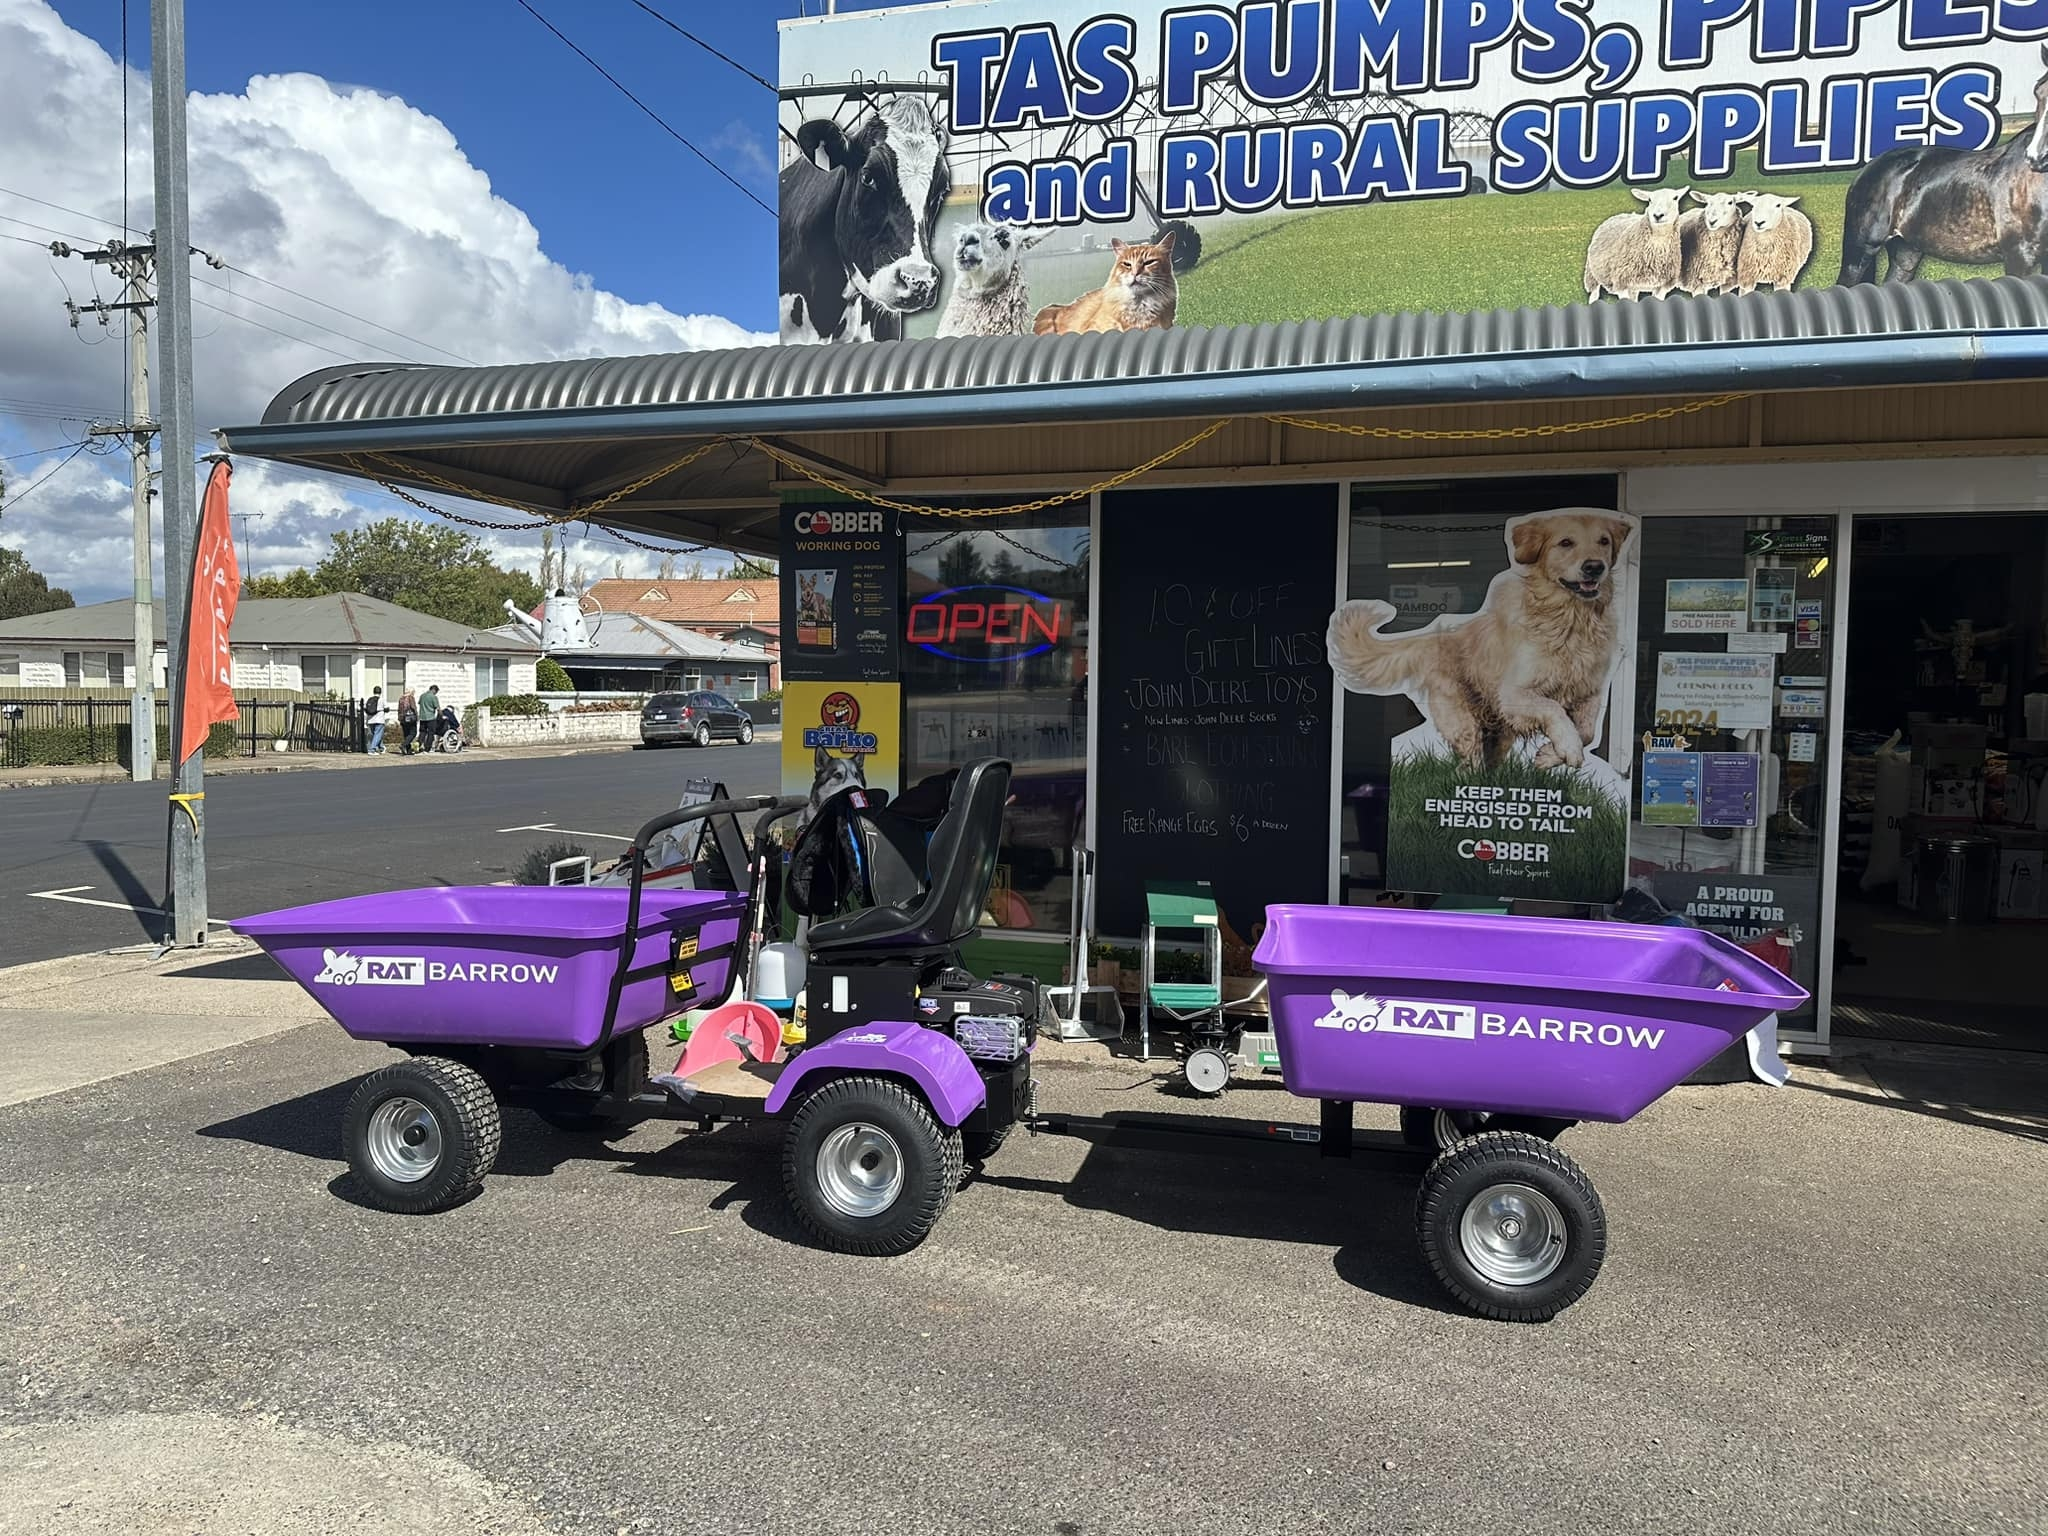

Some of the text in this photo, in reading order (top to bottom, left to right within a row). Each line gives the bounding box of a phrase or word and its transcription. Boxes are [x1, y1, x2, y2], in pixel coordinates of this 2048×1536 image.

[933, 18, 1136, 133] TAS
[1162, 0, 1640, 110] PUMPS,
[984, 64, 2000, 224] and RURAL SUPPLIES
[794, 511, 883, 534] COBBER
[796, 541, 880, 551] WORKING DOG
[1230, 583, 1295, 619] OFF
[907, 603, 1061, 644] OPEN
[1671, 619, 1737, 629] SOLD HERE
[1184, 624, 1322, 675] GIFT LINES
[1129, 672, 1317, 710] JOHN DEERE TOYS
[1249, 711, 1277, 723] SOCKS
[1655, 709, 1718, 735] 2024
[804, 729, 877, 748] Barko
[967, 729, 987, 737] 224
[1651, 737, 1676, 748] RAW
[1455, 785, 1562, 802] KEEP THEM
[1425, 799, 1592, 819] ENERGISED FROM
[1122, 809, 1146, 834] FREE
[1148, 808, 1183, 833] RANGE
[1187, 812, 1219, 836] EGGS
[1230, 814, 1249, 841] $6
[1440, 814, 1575, 833] HEAD TO TAIL.
[1457, 839, 1549, 863] COBBER
[1488, 863, 1550, 881] Fuel their Spirit
[1697, 886, 1774, 903] A PROUD
[1684, 903, 1785, 921] AGENT FOR
[366, 962, 558, 984] RAT BARROW
[1393, 1007, 1666, 1050] RAT BARROW
